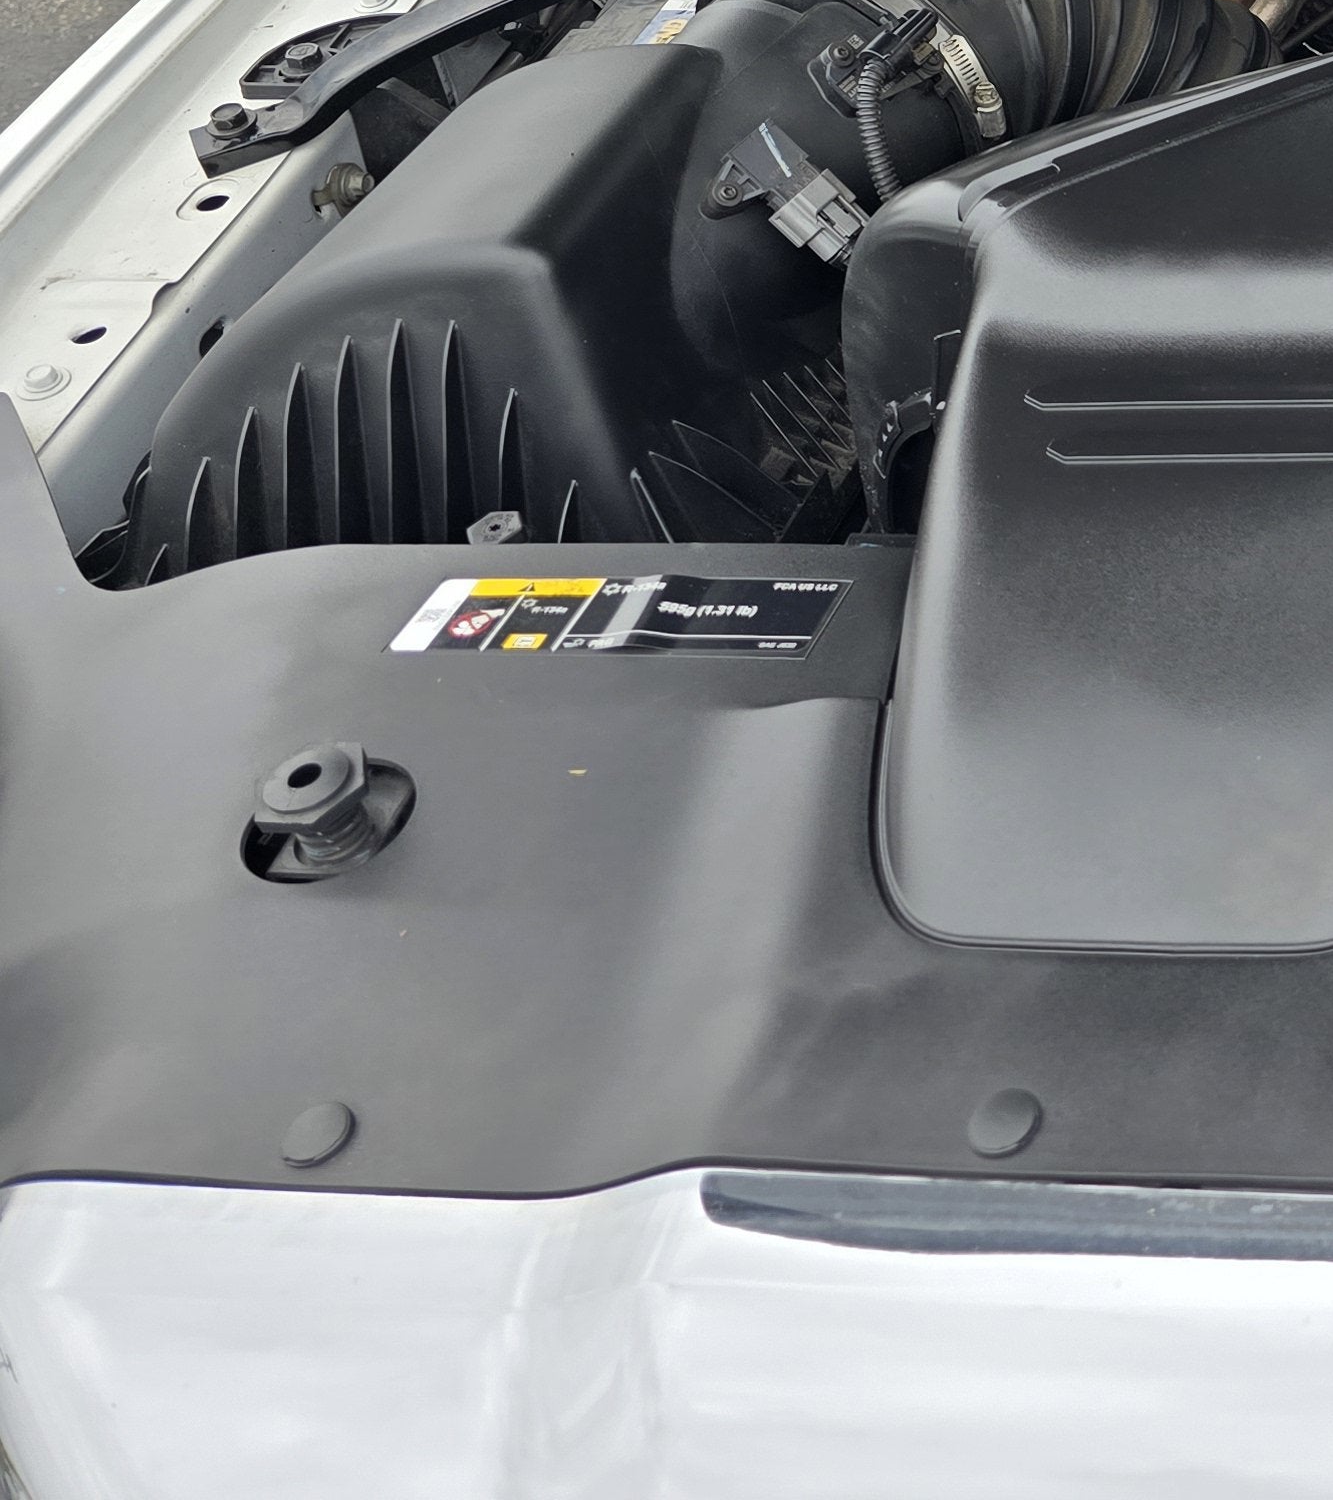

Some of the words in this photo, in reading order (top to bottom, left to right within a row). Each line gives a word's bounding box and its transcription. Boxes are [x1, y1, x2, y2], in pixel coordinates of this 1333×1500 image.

[773, 582, 797, 591] FCA
[815, 582, 838, 592] LLC
[736, 605, 759, 618] lb)
